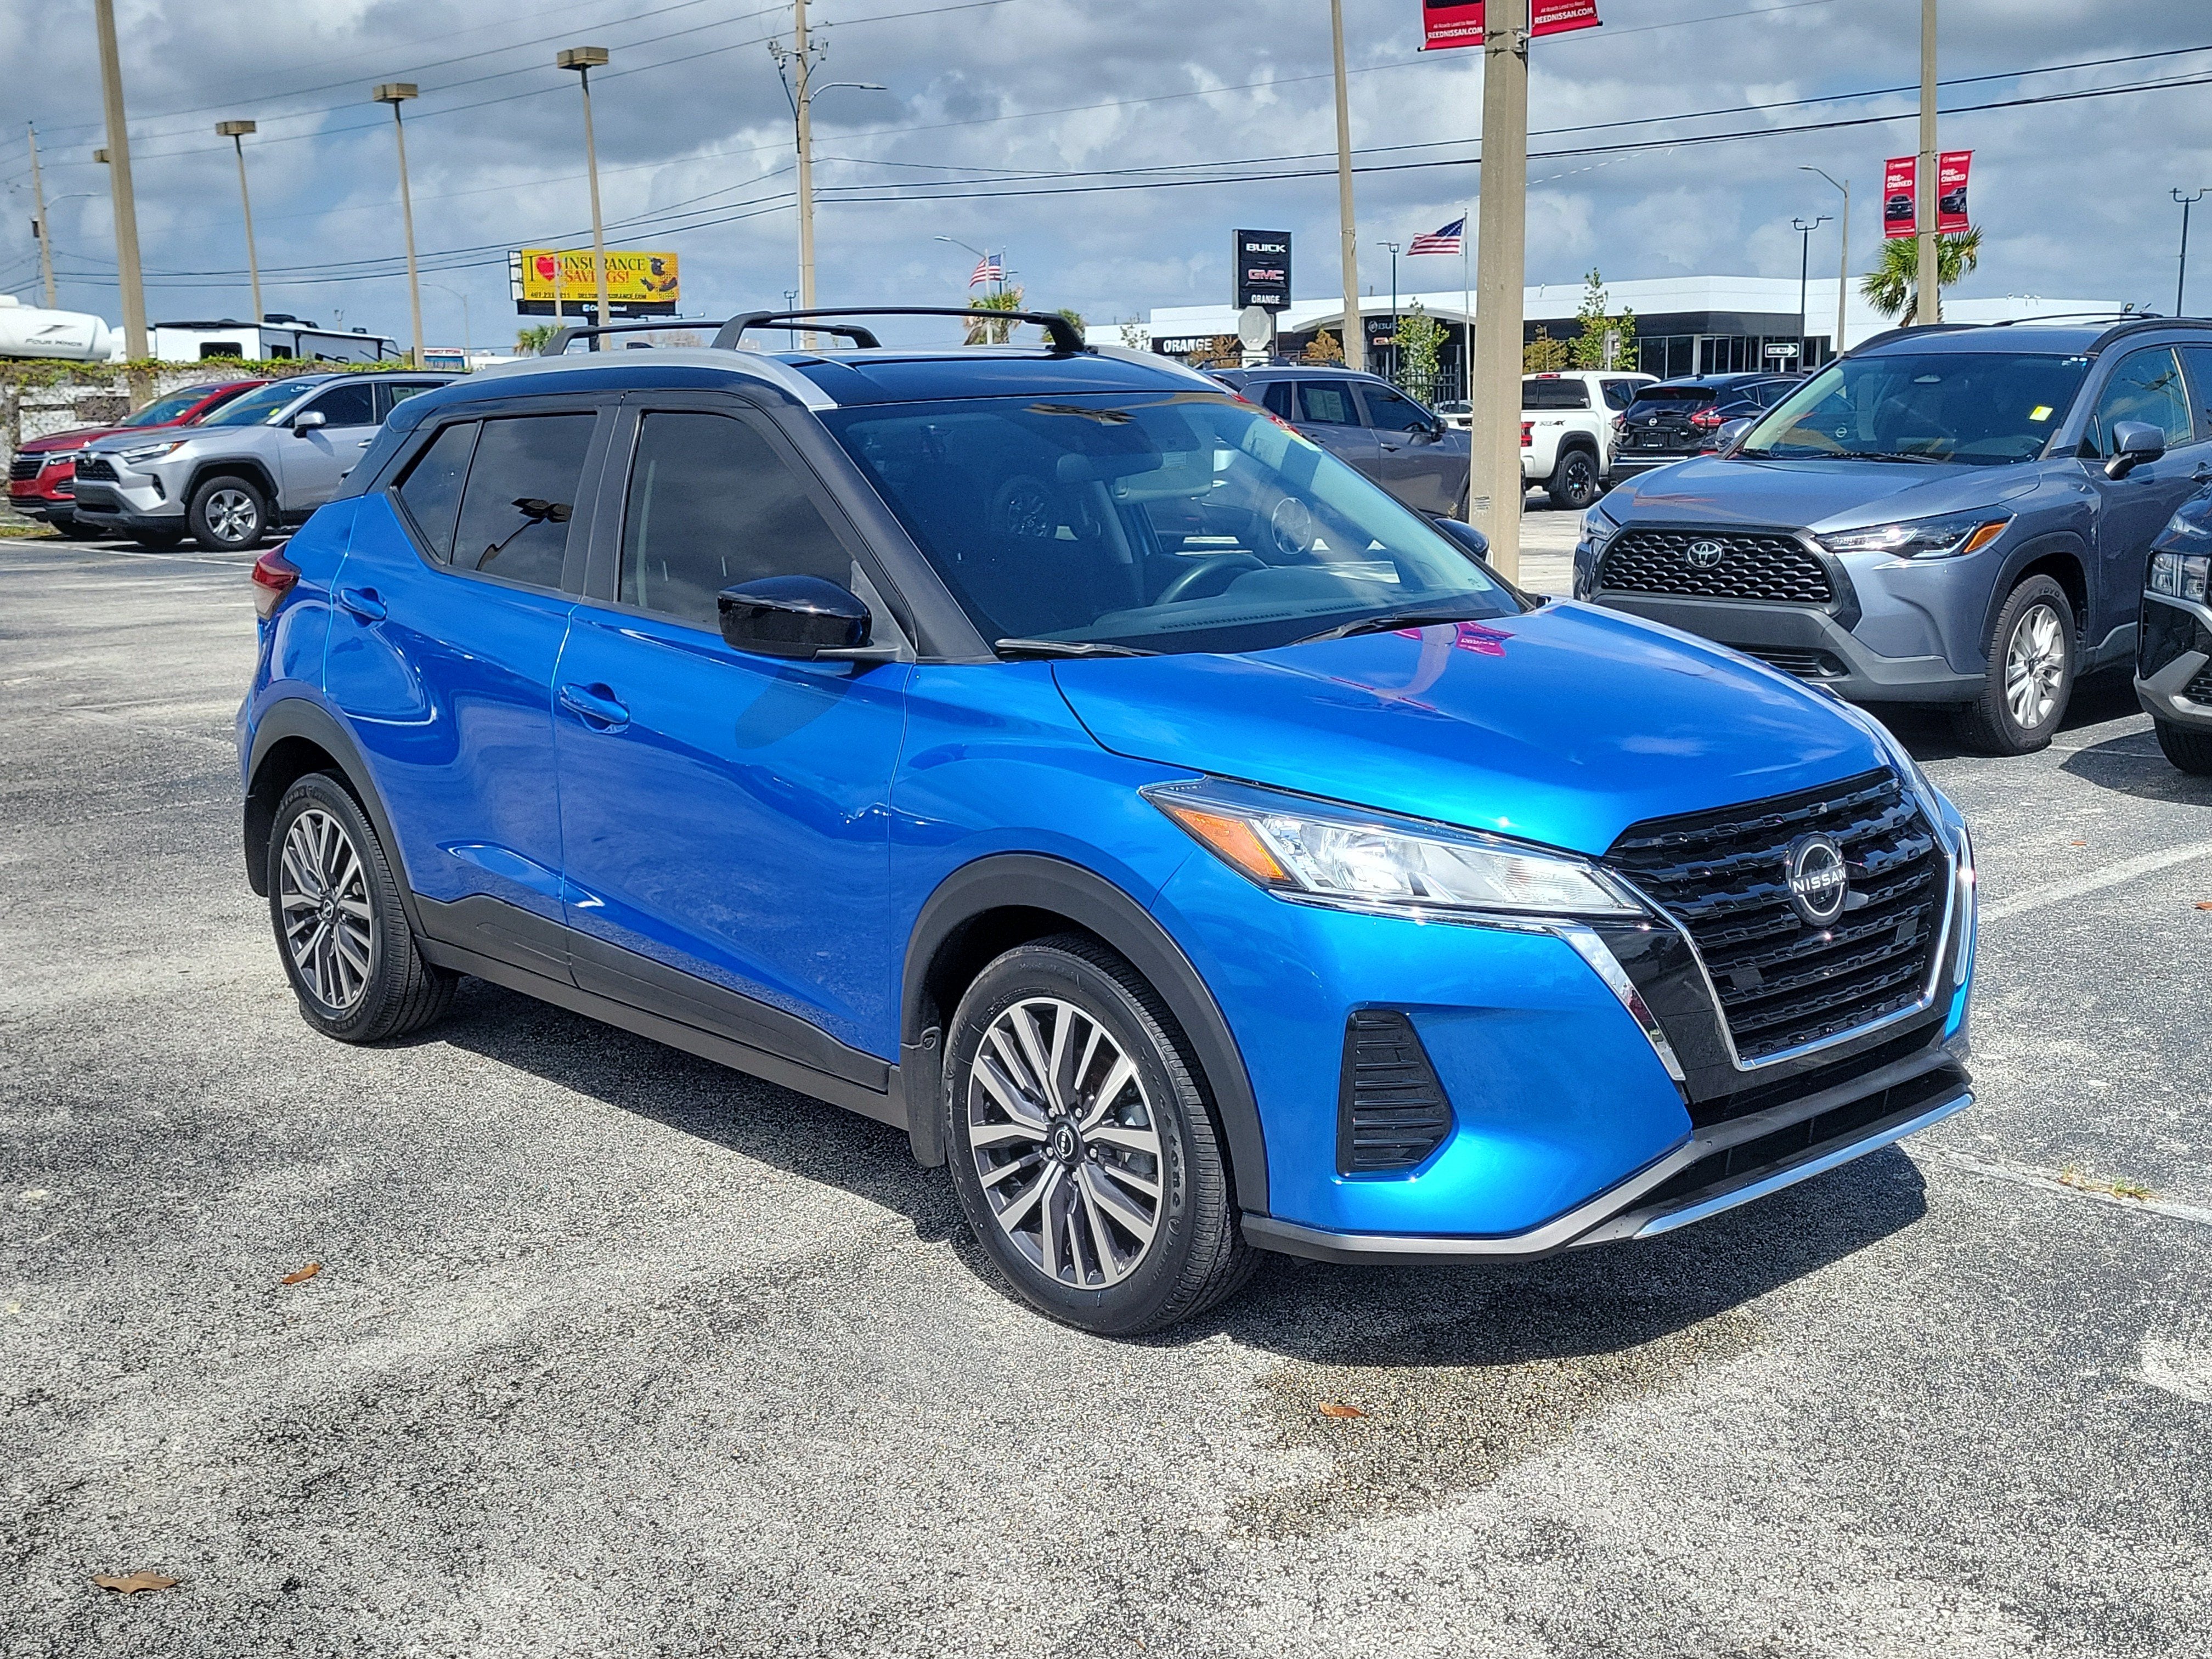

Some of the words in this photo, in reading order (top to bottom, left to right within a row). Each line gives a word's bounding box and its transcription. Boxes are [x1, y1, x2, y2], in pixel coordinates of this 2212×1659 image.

[1534, 7, 1594, 24] REEDNISSAN.COM
[1427, 26, 1483, 38] REEDNISSAN.COM
[1941, 173, 1966, 183] OWNED
[1887, 179, 1913, 189] OWNED
[1246, 243, 1286, 252] BUICK
[565, 269, 629, 283] SAVIGS!
[1248, 269, 1284, 280] GMC
[1251, 294, 1280, 304] ORANGE
[1163, 338, 1213, 353] ORANGE
[1793, 867, 1847, 893] NISSAN
